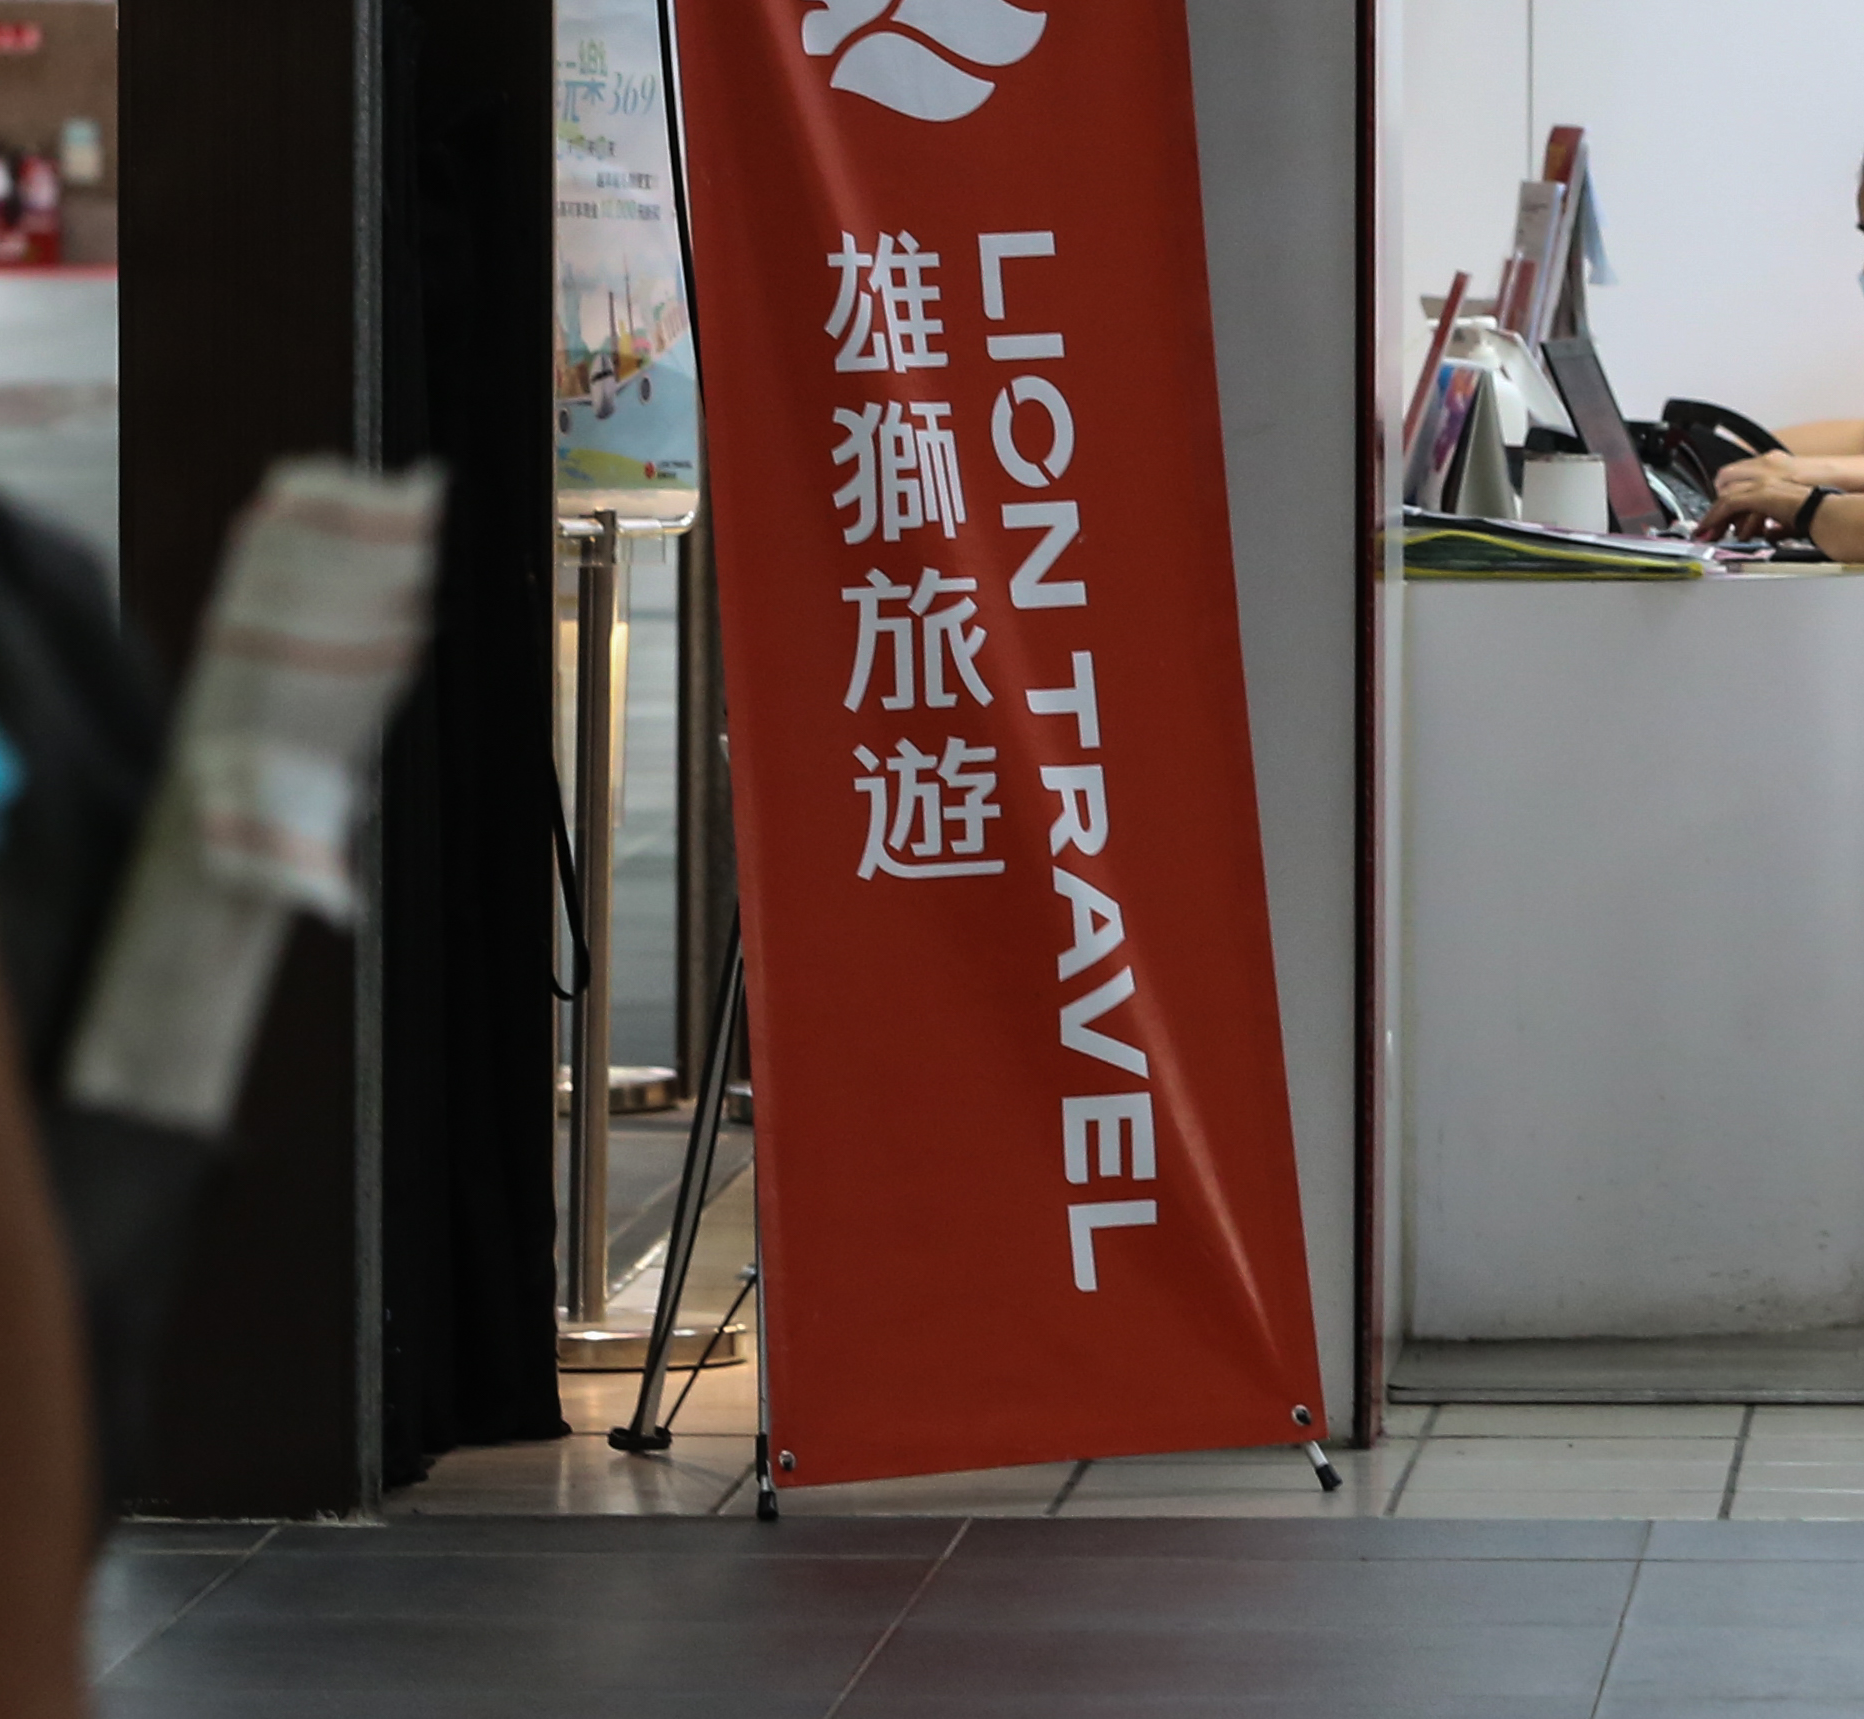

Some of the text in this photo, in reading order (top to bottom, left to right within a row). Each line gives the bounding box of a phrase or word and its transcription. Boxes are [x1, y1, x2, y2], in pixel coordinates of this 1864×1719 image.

[823, 229, 1006, 882] 雄獅旅遊
[977, 230, 1159, 1294] LION TRAVEL
